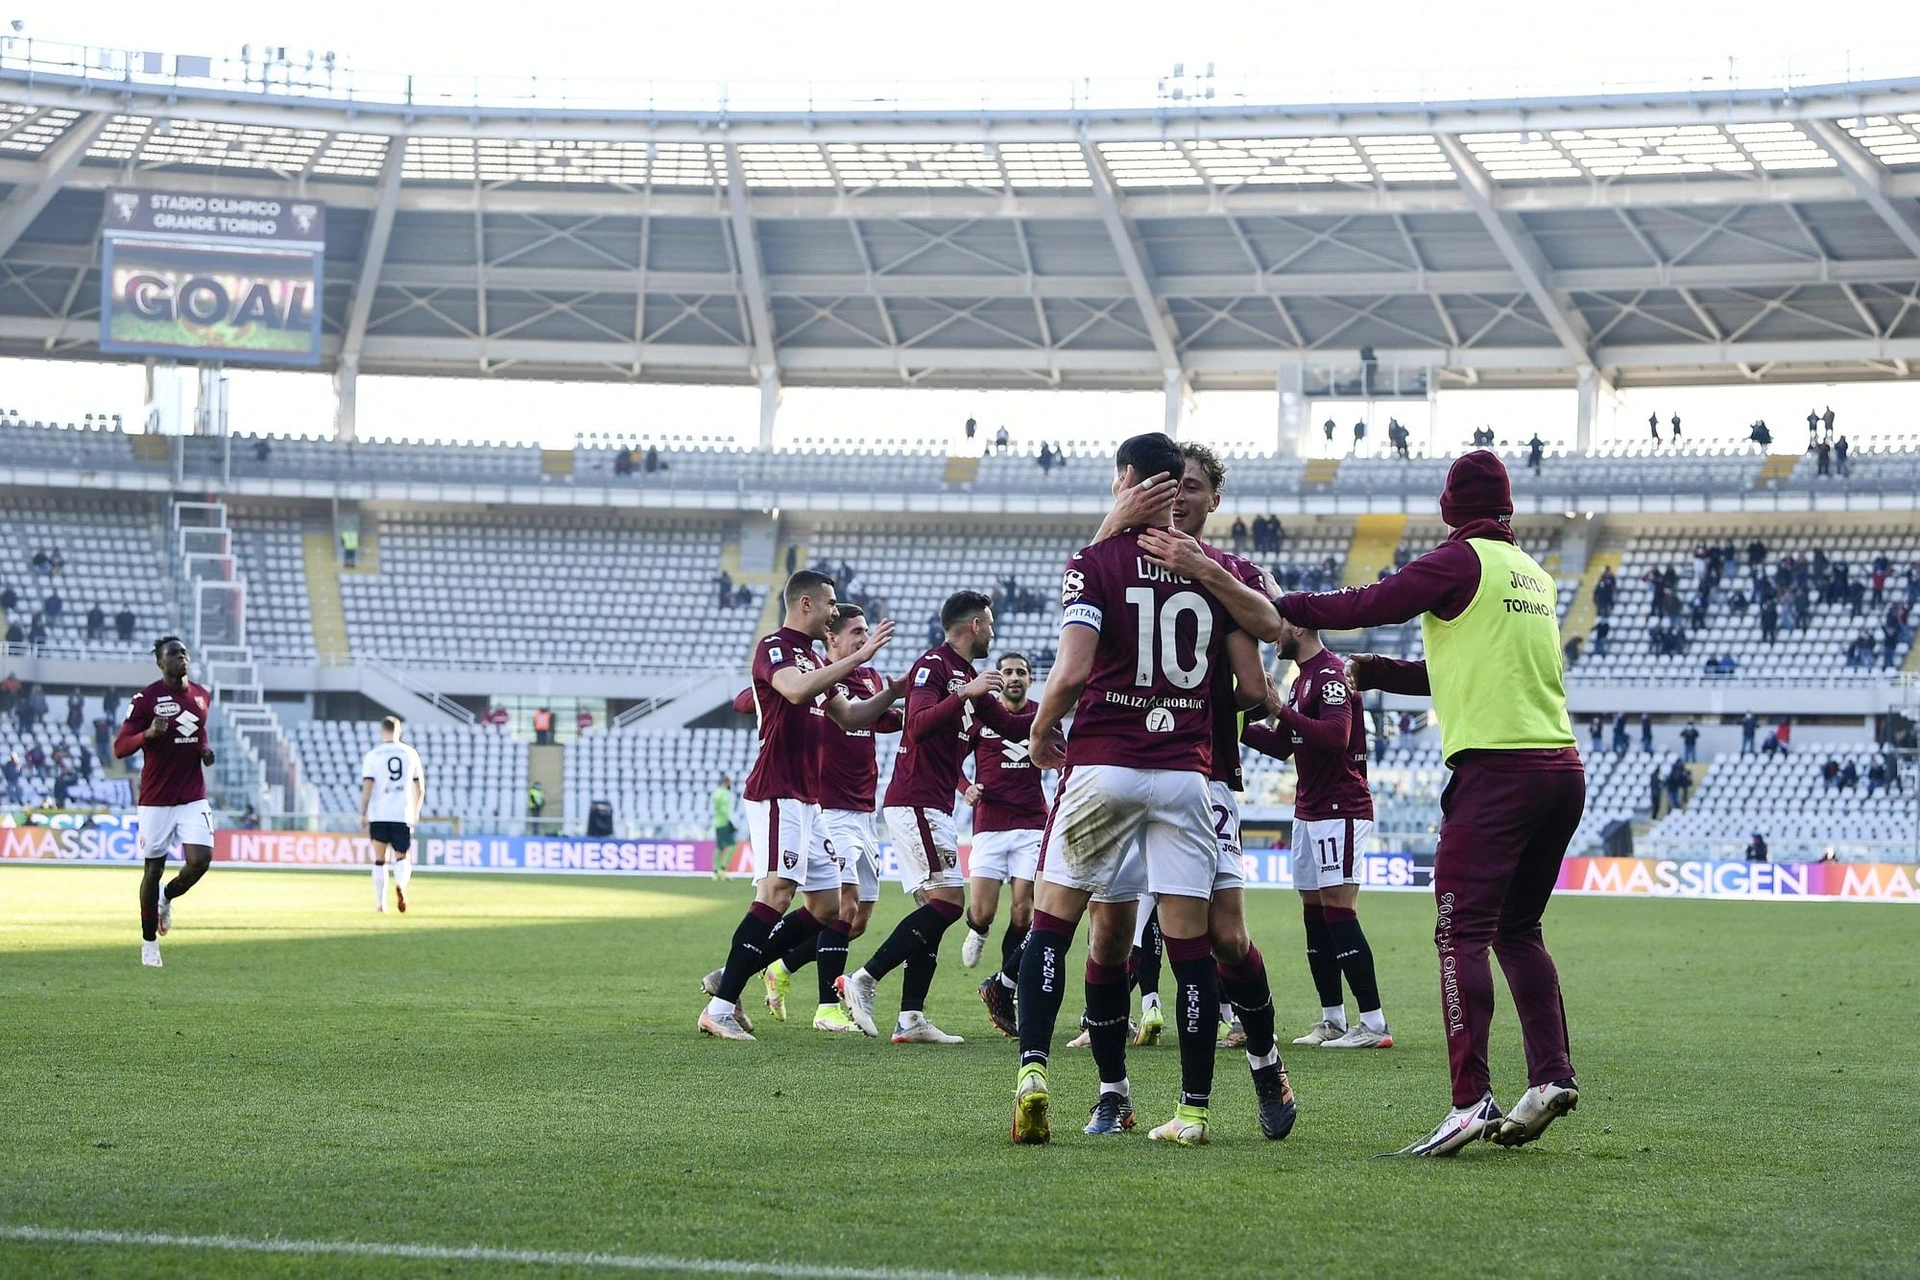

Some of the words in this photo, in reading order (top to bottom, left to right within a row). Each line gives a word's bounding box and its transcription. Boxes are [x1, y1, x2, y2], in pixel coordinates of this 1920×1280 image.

[151, 195, 206, 212] STADIO
[207, 198, 281, 217] OLIMPICO
[153, 213, 216, 231] GRANDE
[219, 217, 277, 235] TORINO
[125, 270, 313, 331] GOAL
[1066, 607, 1101, 625] APITANO
[1503, 598, 1550, 616] TORINO
[1126, 587, 1214, 690] 10
[1322, 681, 1347, 698] 38
[388, 756, 403, 781] 9
[3, 827, 185, 861] MASSIG
[230, 834, 419, 866] INTEGRATI
[426, 839, 483, 869] PER
[490, 840, 518, 869] IL
[524, 841, 695, 872] BENESSERE
[1318, 837, 1338, 865] 11
[1582, 860, 1807, 895] MASSIGEN
[1839, 863, 1920, 898] MA
[1444, 956, 1464, 1037] TORINO
